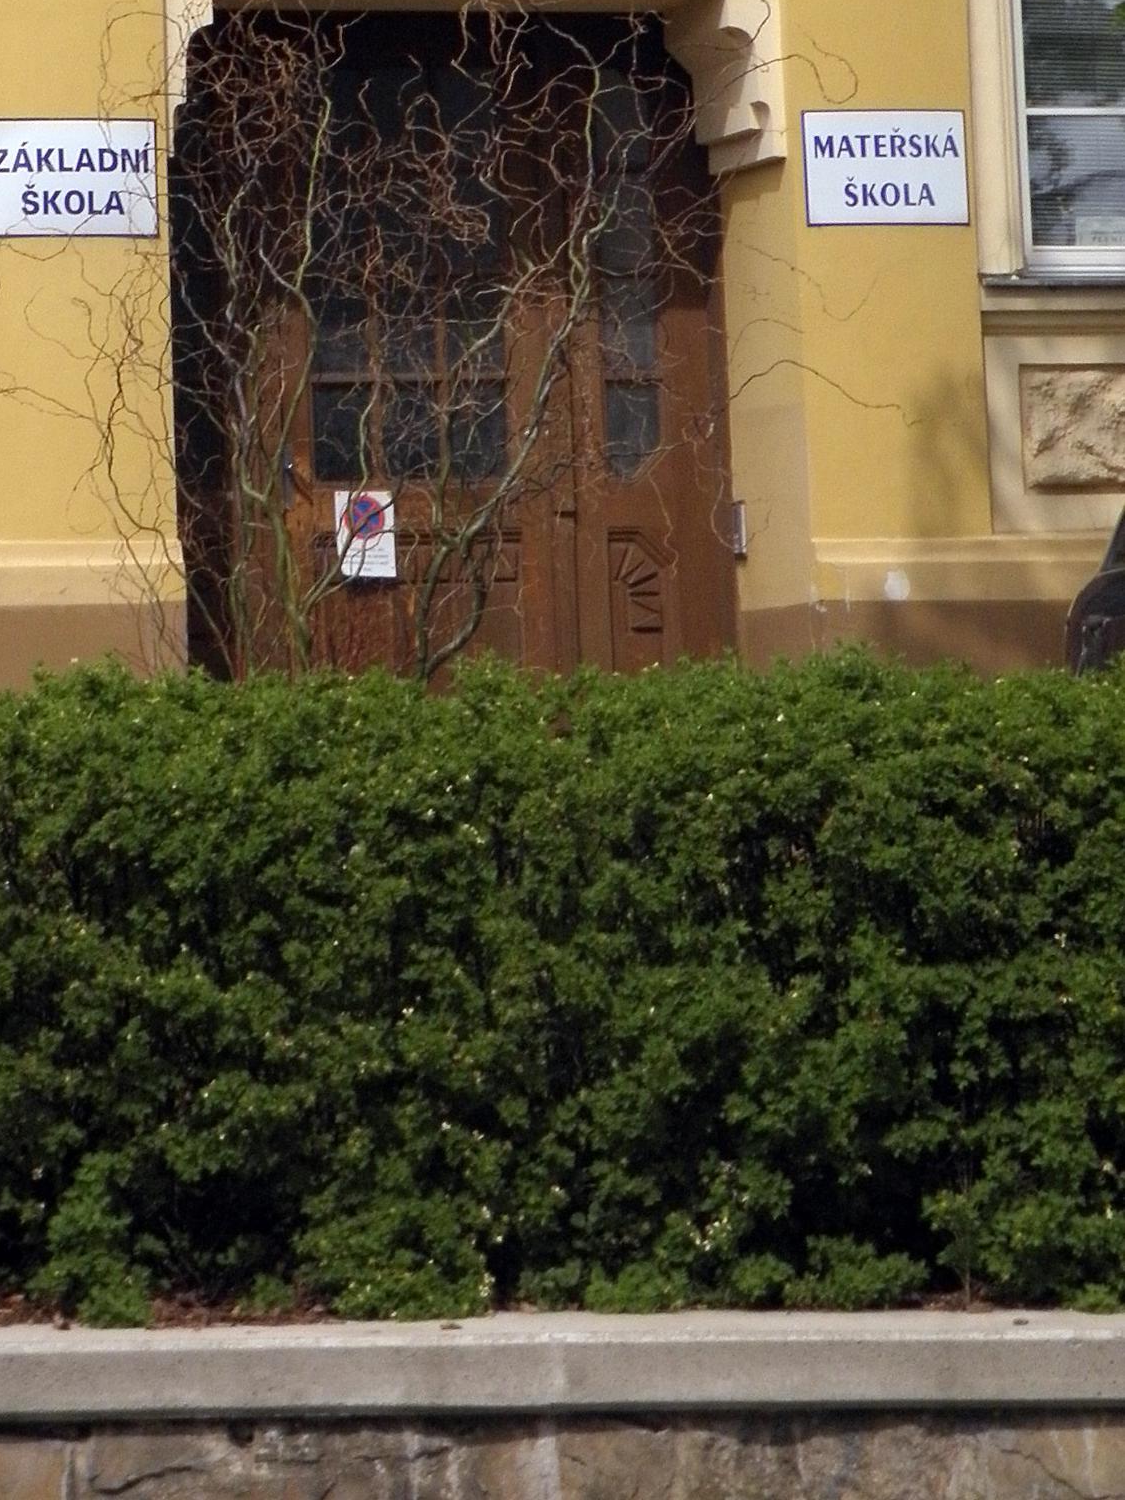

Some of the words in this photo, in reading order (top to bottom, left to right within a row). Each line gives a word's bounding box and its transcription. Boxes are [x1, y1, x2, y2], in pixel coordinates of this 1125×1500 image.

[813, 127, 959, 158] MATEŘSKÁ
[21, 183, 125, 215] ŠKOLA
[844, 176, 935, 207] ŠKOLA
